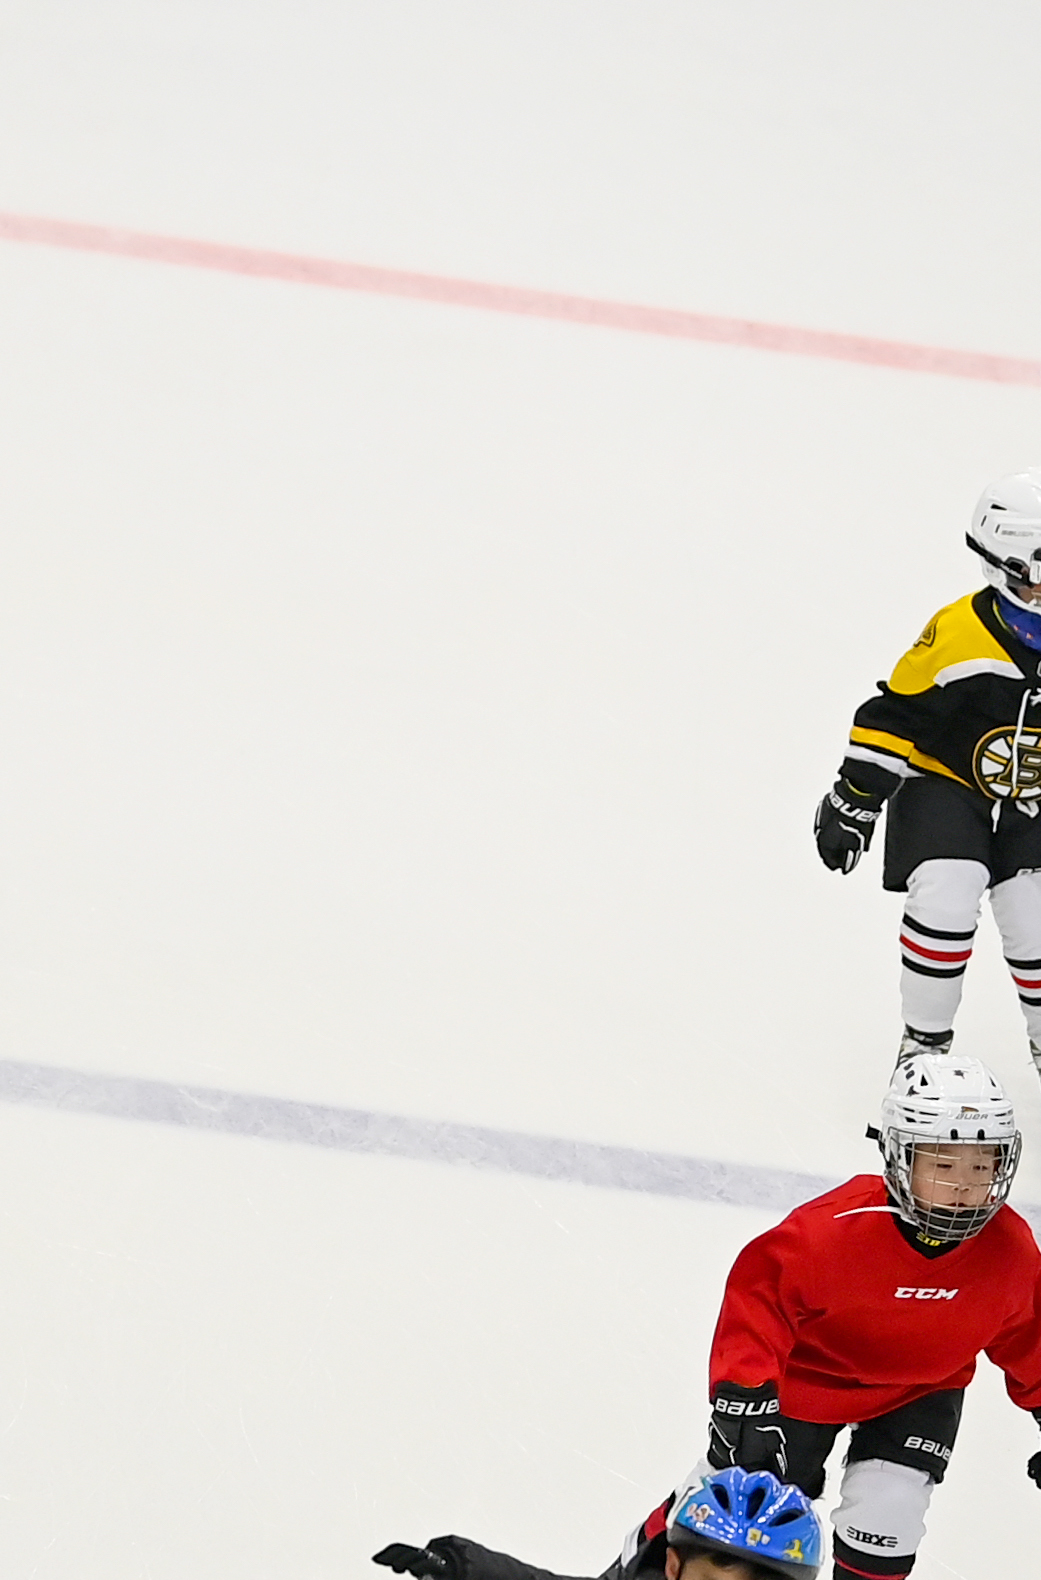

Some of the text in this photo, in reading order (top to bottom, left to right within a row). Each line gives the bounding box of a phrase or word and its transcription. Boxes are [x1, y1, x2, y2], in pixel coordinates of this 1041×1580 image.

[829, 791, 881, 822] AUER
[894, 1287, 959, 1300] CCM
[715, 1398, 780, 1416] BAUE
